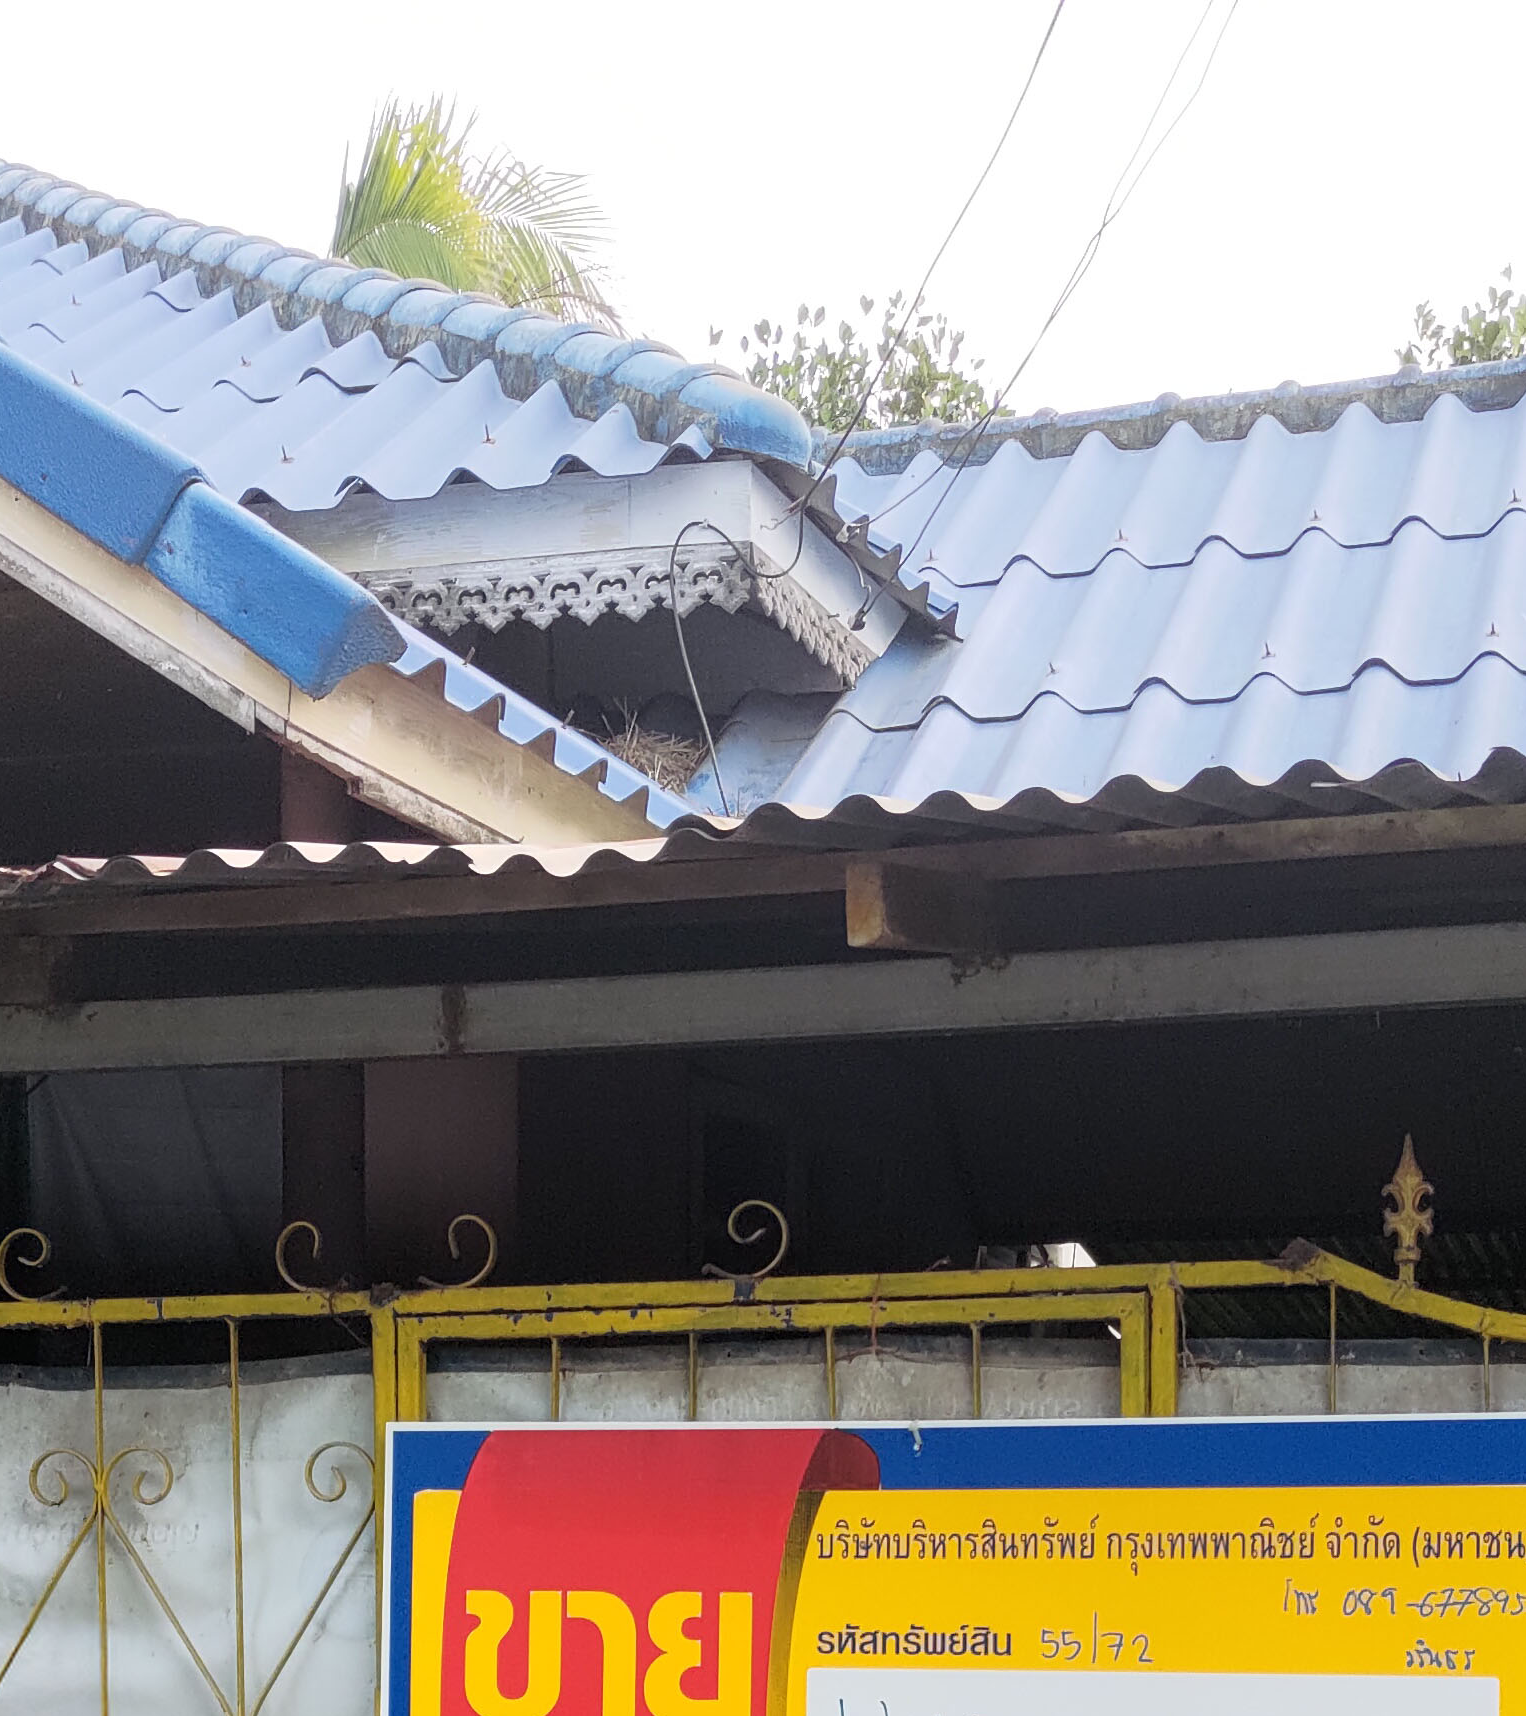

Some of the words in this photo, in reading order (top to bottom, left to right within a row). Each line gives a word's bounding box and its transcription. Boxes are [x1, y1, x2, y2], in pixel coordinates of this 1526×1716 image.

[816, 1513, 1100, 1562] บริษัทบริหารสินทรัพย์
[1106, 1513, 1319, 1577] กรุงเทพพาณิชย์
[1325, 1515, 1401, 1560] จำกัด
[816, 1623, 1012, 1657] รหัสทรัพย์สิน
[1041, 1611, 1154, 1664] 55/72
